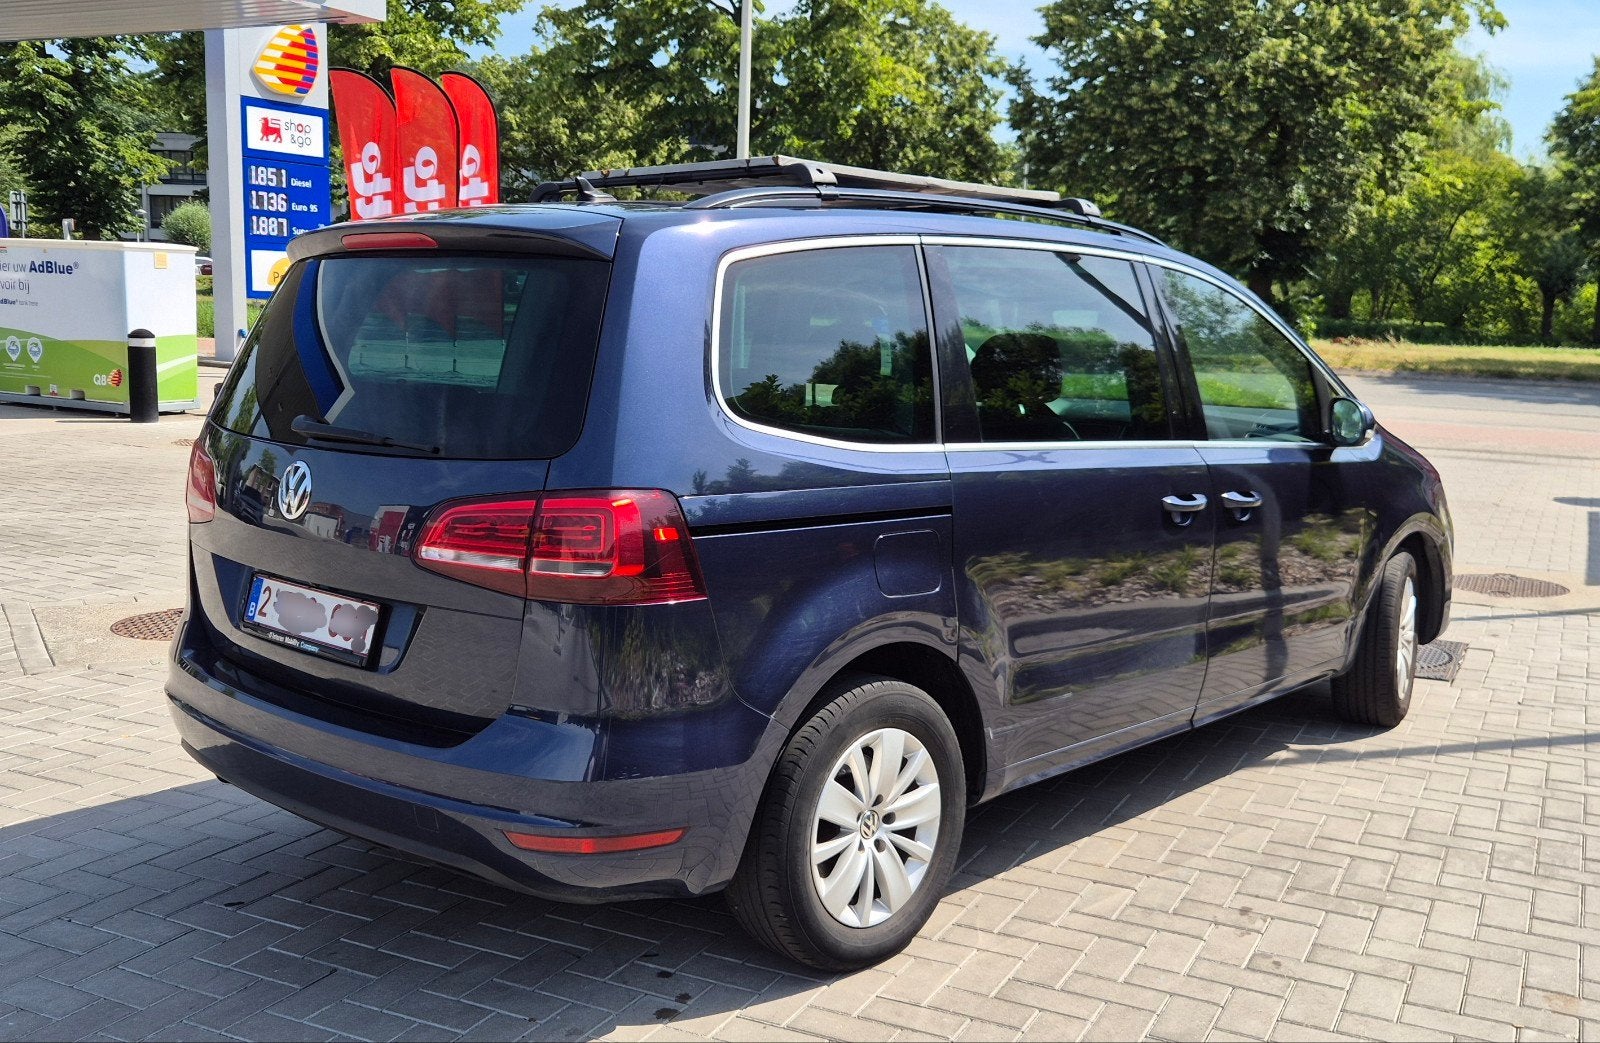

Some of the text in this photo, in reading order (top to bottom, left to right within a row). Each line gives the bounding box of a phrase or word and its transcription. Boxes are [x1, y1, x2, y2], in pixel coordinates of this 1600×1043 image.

[284, 118, 312, 136] shop
[290, 133, 312, 148] &go
[290, 178, 312, 188] Diesel
[291, 202, 308, 212] Euro
[309, 203, 319, 213] 95
[13, 264, 27, 273] uw
[18, 279, 30, 294] bij
[93, 373, 107, 386] Q8
[247, 601, 256, 617] B
